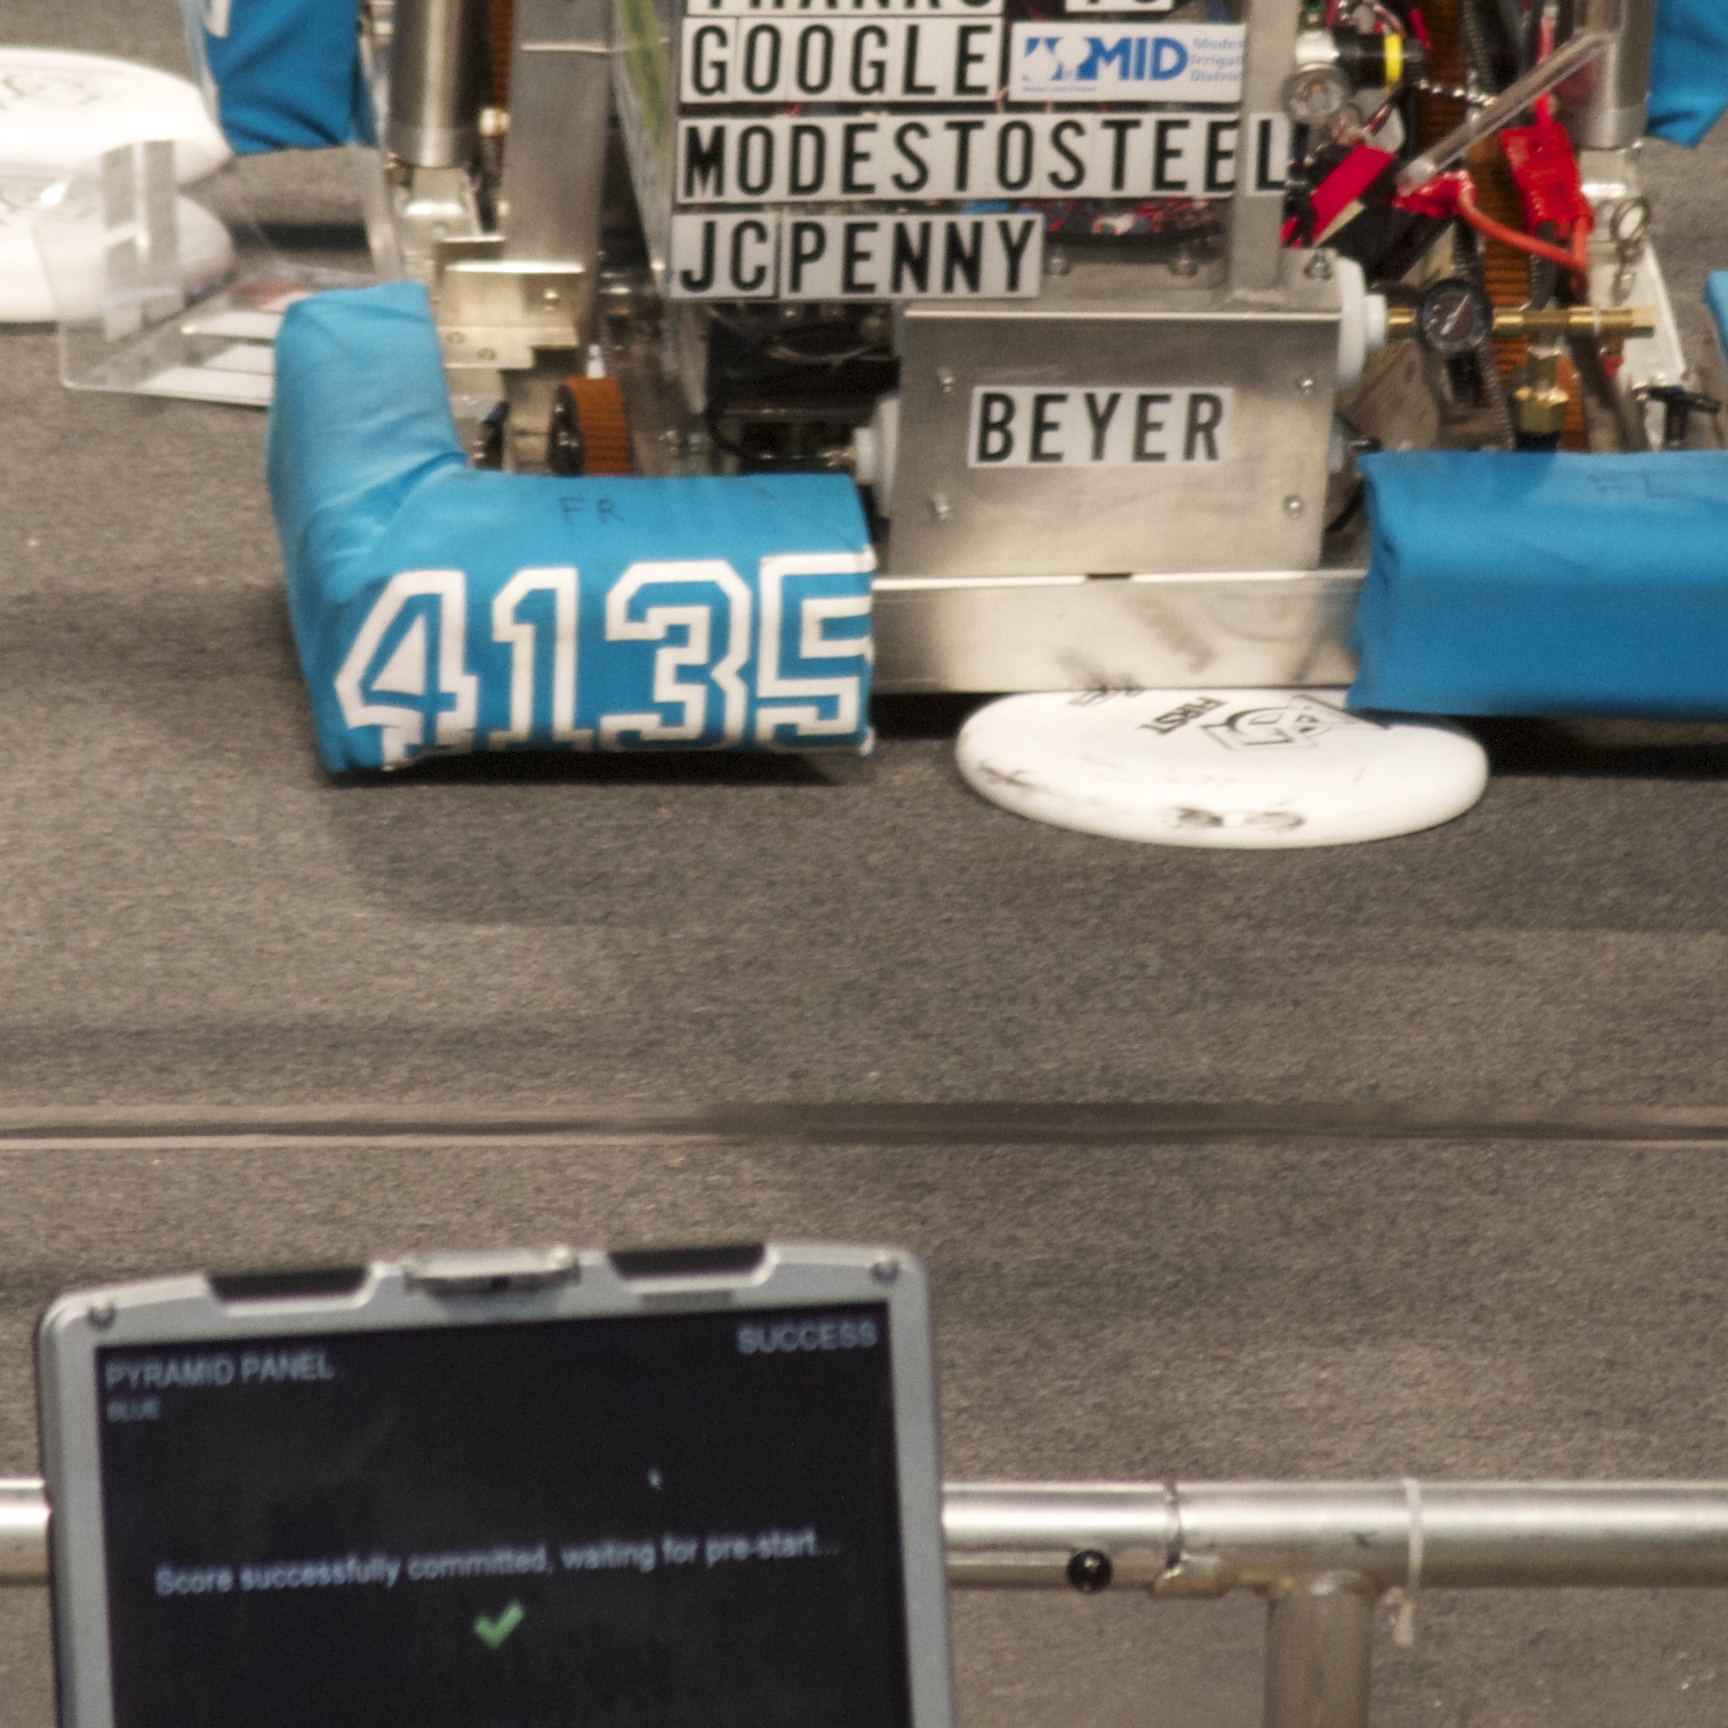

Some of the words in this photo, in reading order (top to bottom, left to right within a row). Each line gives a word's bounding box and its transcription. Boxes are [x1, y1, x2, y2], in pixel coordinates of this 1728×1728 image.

[690, 23, 993, 97] GOOGLE
[1075, 36, 1188, 81] MID
[680, 218, 1036, 294] JCPENNY
[975, 391, 1223, 464] BEYER
[334, 545, 875, 772] 4135
[106, 1356, 236, 1390] PYRAMID
[240, 1349, 335, 1383] PANEL
[736, 1322, 878, 1355] SUCCESS
[154, 1561, 234, 1597] Score
[239, 1551, 402, 1590] successfully
[406, 1540, 553, 1581] committed,
[559, 1535, 657, 1573] waiting
[662, 1530, 700, 1565] for
